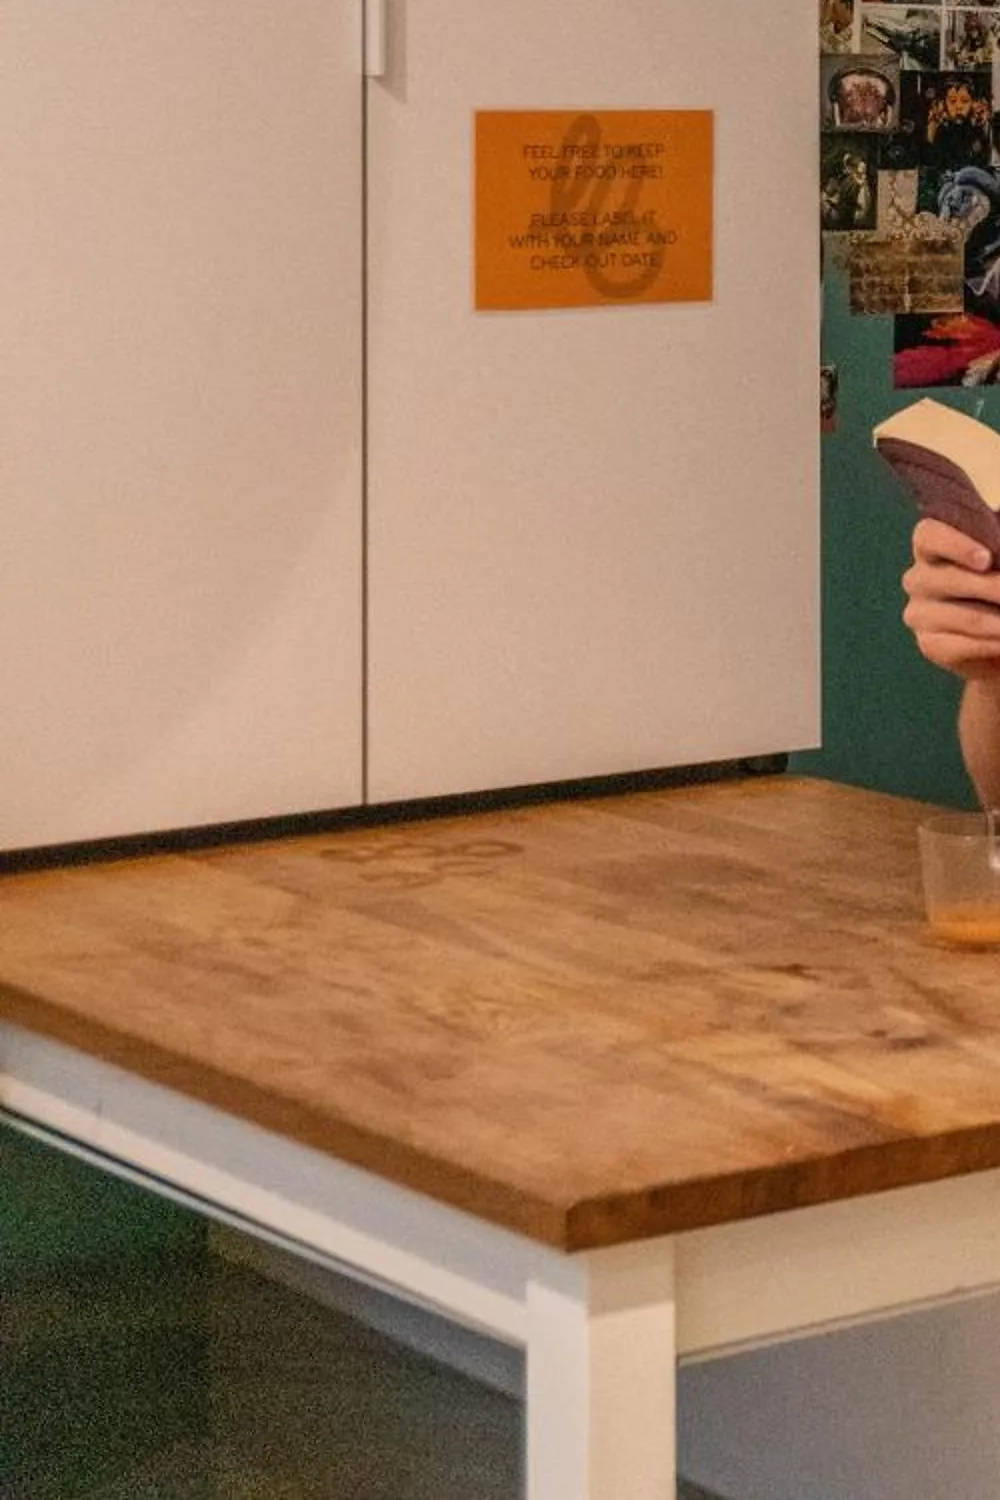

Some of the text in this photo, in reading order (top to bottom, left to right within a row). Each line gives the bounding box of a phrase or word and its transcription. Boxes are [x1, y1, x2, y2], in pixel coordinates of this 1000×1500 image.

[523, 143, 560, 160] FEEL
[528, 165, 571, 181] YOUR
[575, 165, 618, 181] FOOD
[530, 212, 591, 228] PLEASE
[508, 233, 550, 250] WITH
[553, 231, 596, 250] YOUR
[645, 229, 679, 247] AND
[584, 252, 618, 270] OUT
[621, 251, 660, 268] DATE
